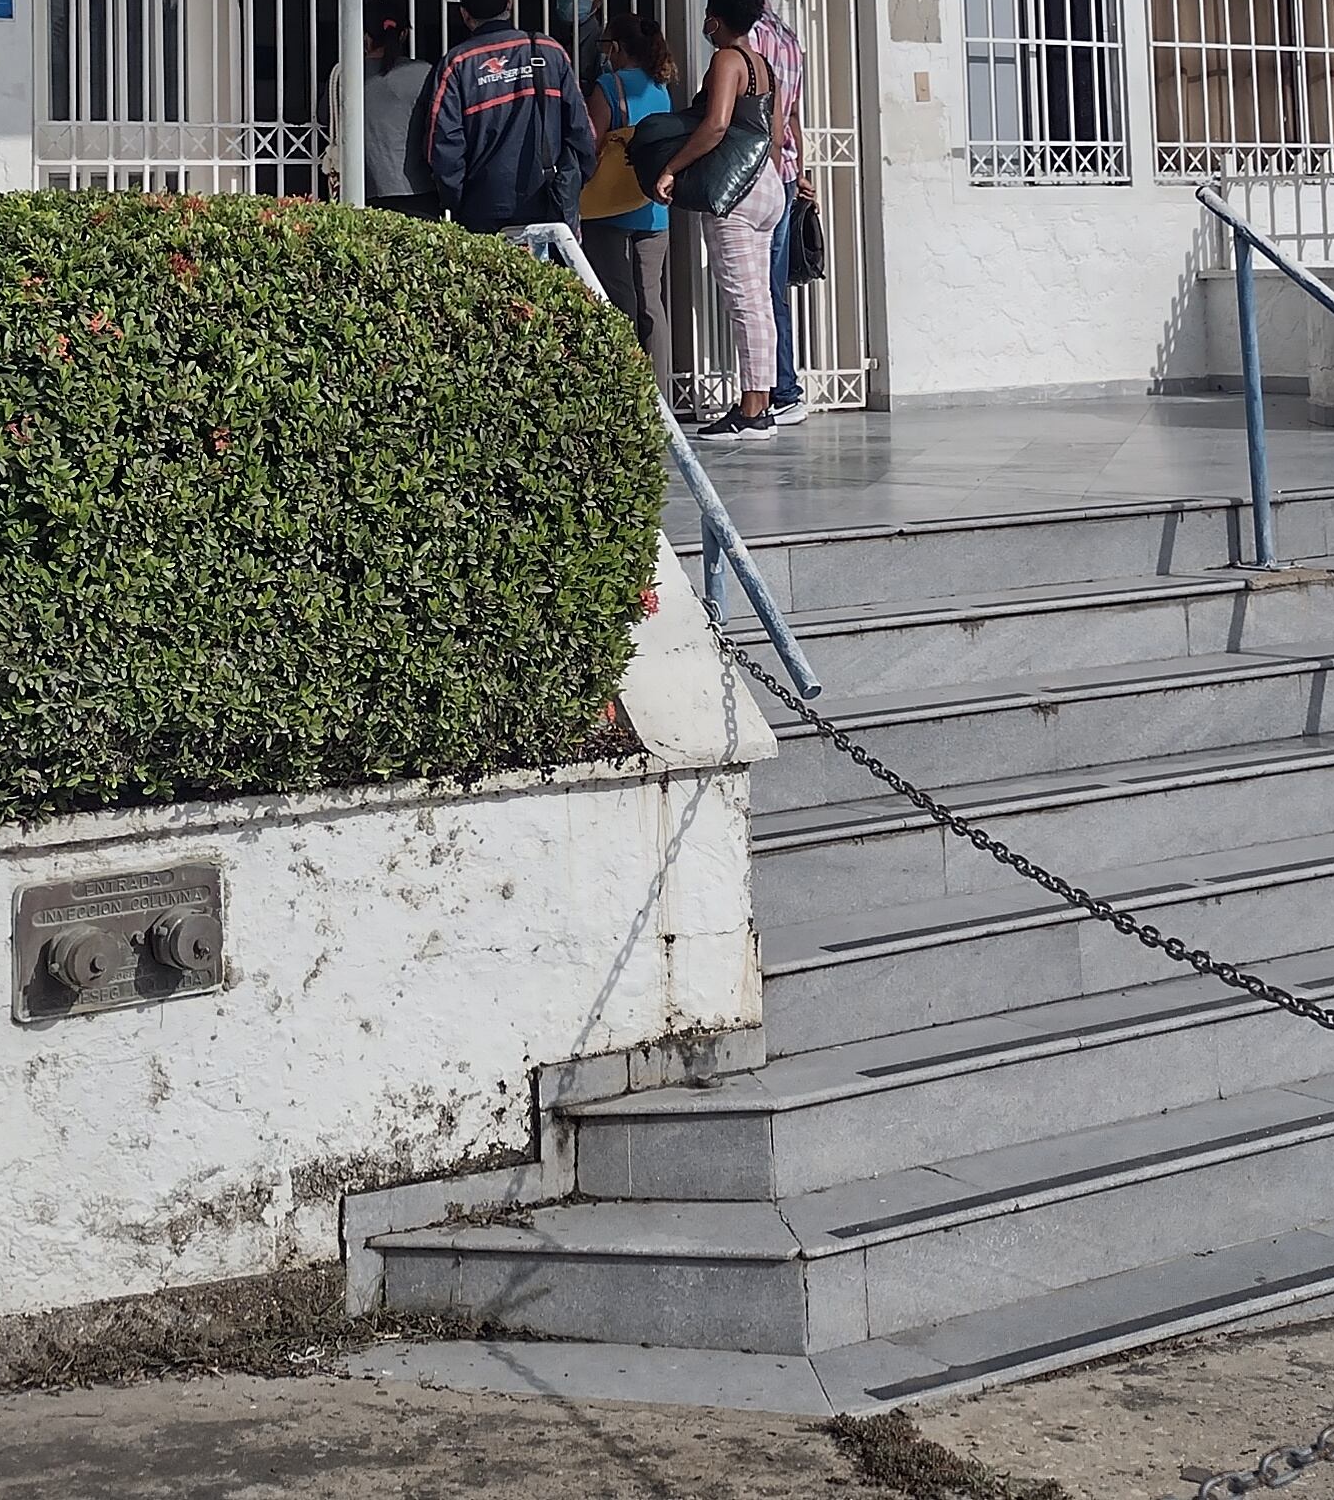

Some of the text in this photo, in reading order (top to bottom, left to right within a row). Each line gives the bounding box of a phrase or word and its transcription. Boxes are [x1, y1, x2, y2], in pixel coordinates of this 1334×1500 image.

[84, 874, 161, 897] ENTRADA
[42, 889, 204, 925] INYECCION COLUMNA
